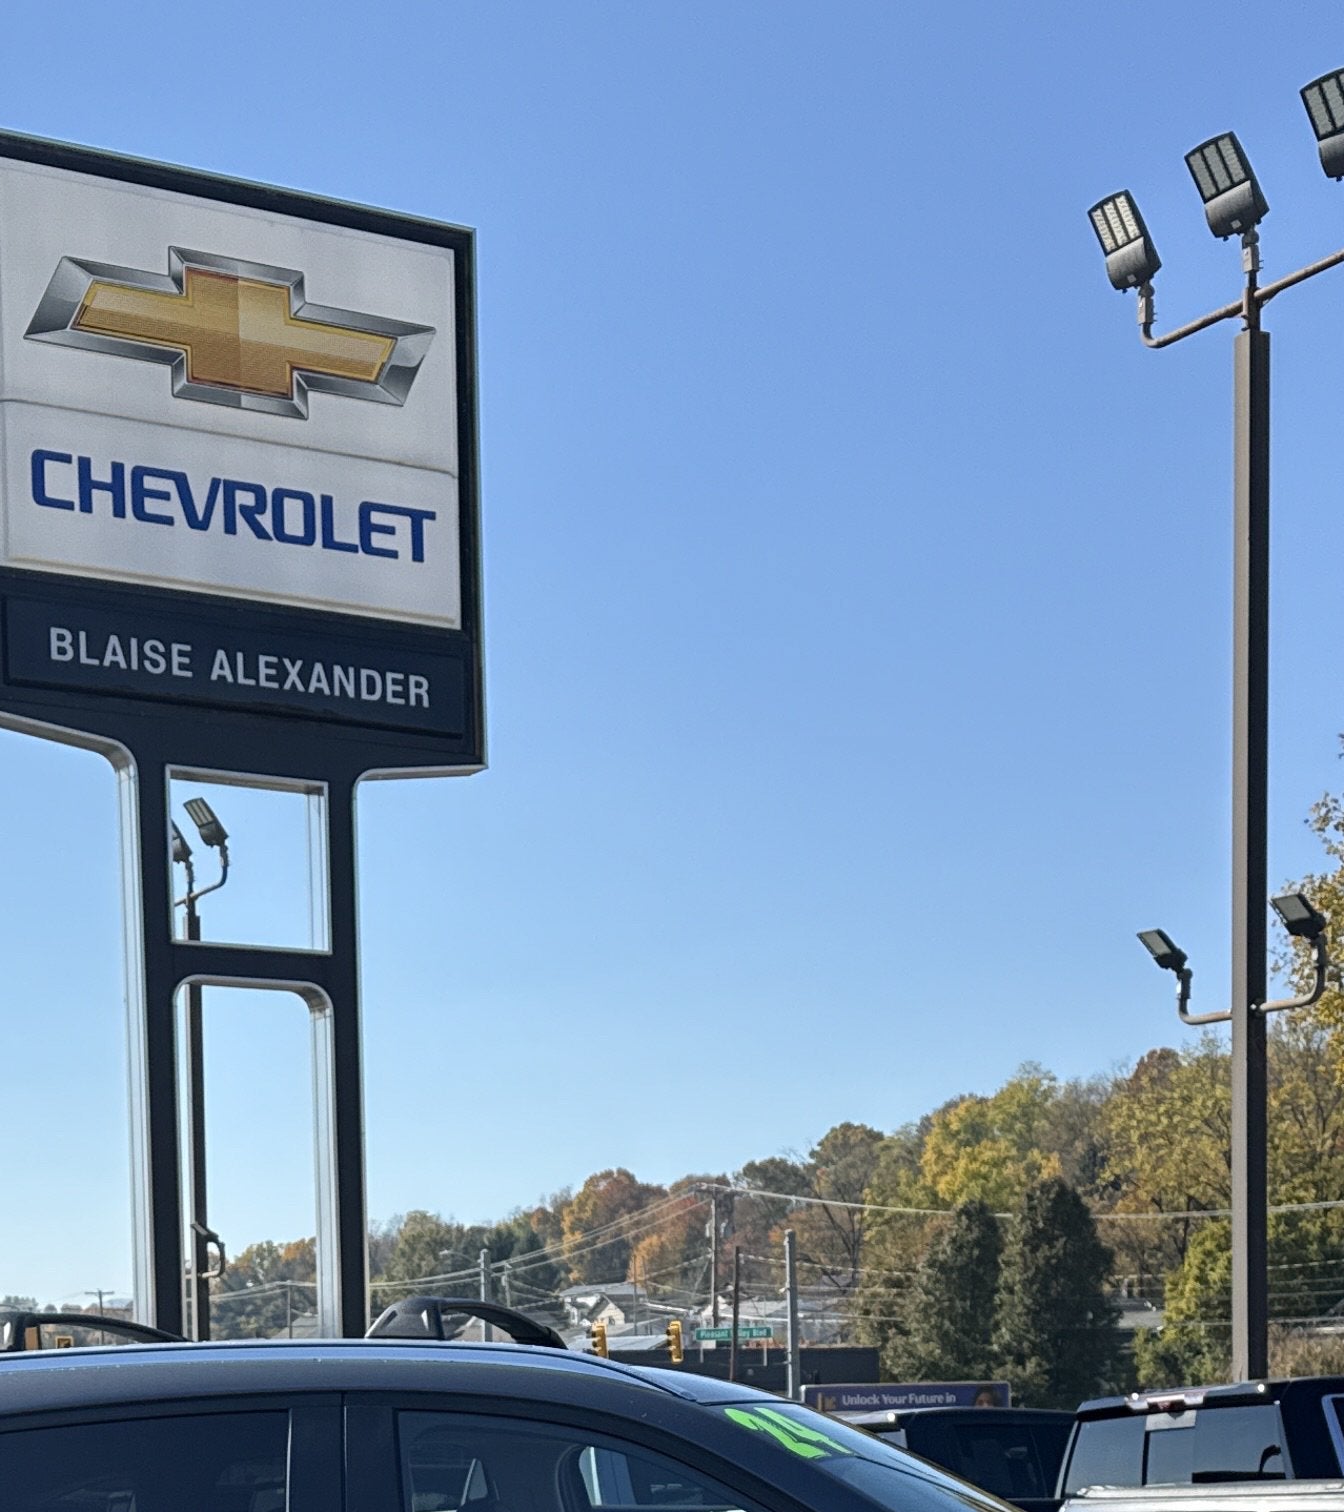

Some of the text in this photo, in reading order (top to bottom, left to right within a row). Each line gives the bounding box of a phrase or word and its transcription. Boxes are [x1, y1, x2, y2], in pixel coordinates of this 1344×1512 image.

[31, 448, 437, 563] CHEVROLET
[48, 626, 431, 708] BLAISE ALEXANDER
[842, 1394, 880, 1406] Unlock
[882, 1393, 908, 1405] Your
[908, 1393, 944, 1404] Future
[945, 1392, 956, 1403] in
